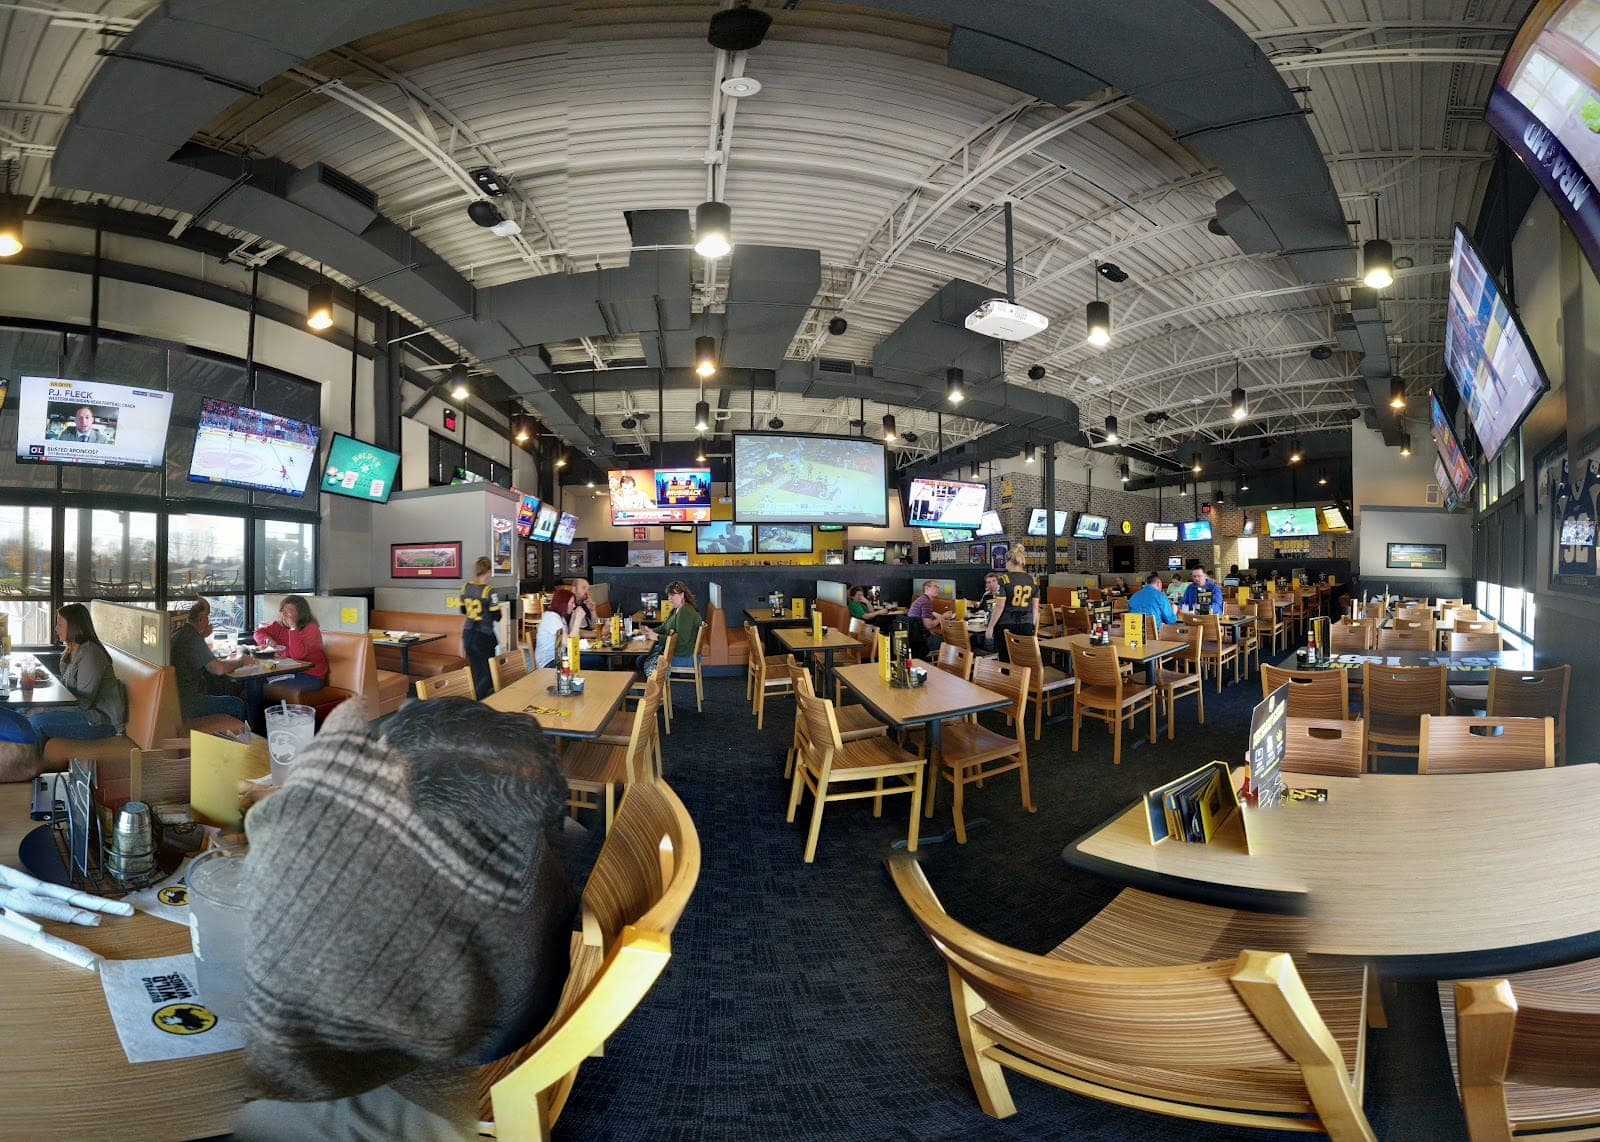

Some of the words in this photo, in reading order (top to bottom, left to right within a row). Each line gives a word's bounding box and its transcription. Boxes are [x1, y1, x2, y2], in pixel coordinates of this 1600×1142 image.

[48, 388, 60, 397] P.J.
[64, 389, 93, 399] FLECK
[30, 445, 44, 455] OL
[1012, 585, 1032, 607] 82
[141, 977, 162, 1003] BUFFALO
[152, 975, 178, 1002] WILD
[167, 974, 193, 1000] WINGS
